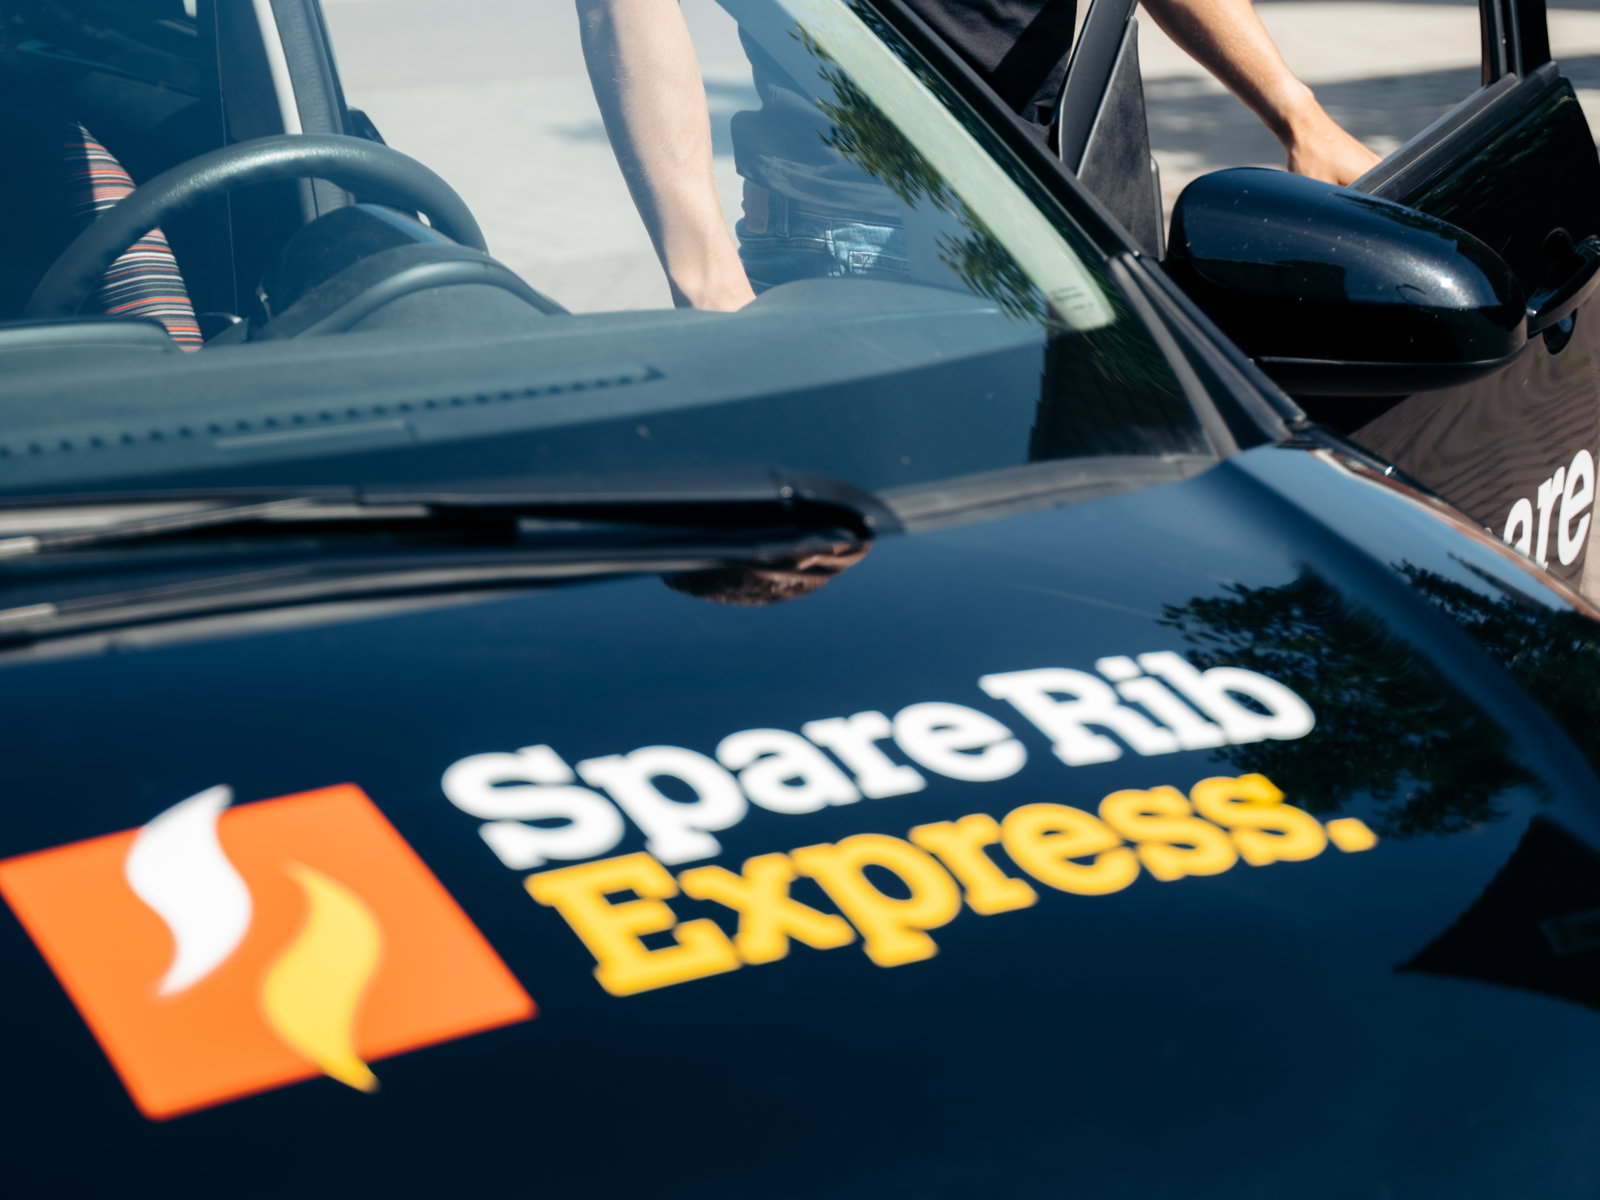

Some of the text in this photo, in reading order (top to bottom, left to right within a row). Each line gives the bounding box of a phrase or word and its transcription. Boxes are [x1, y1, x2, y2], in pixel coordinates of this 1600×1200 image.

[1484, 449, 1595, 572] are
[442, 650, 1316, 870] Spare Rib
[524, 773, 1378, 997] Express.
